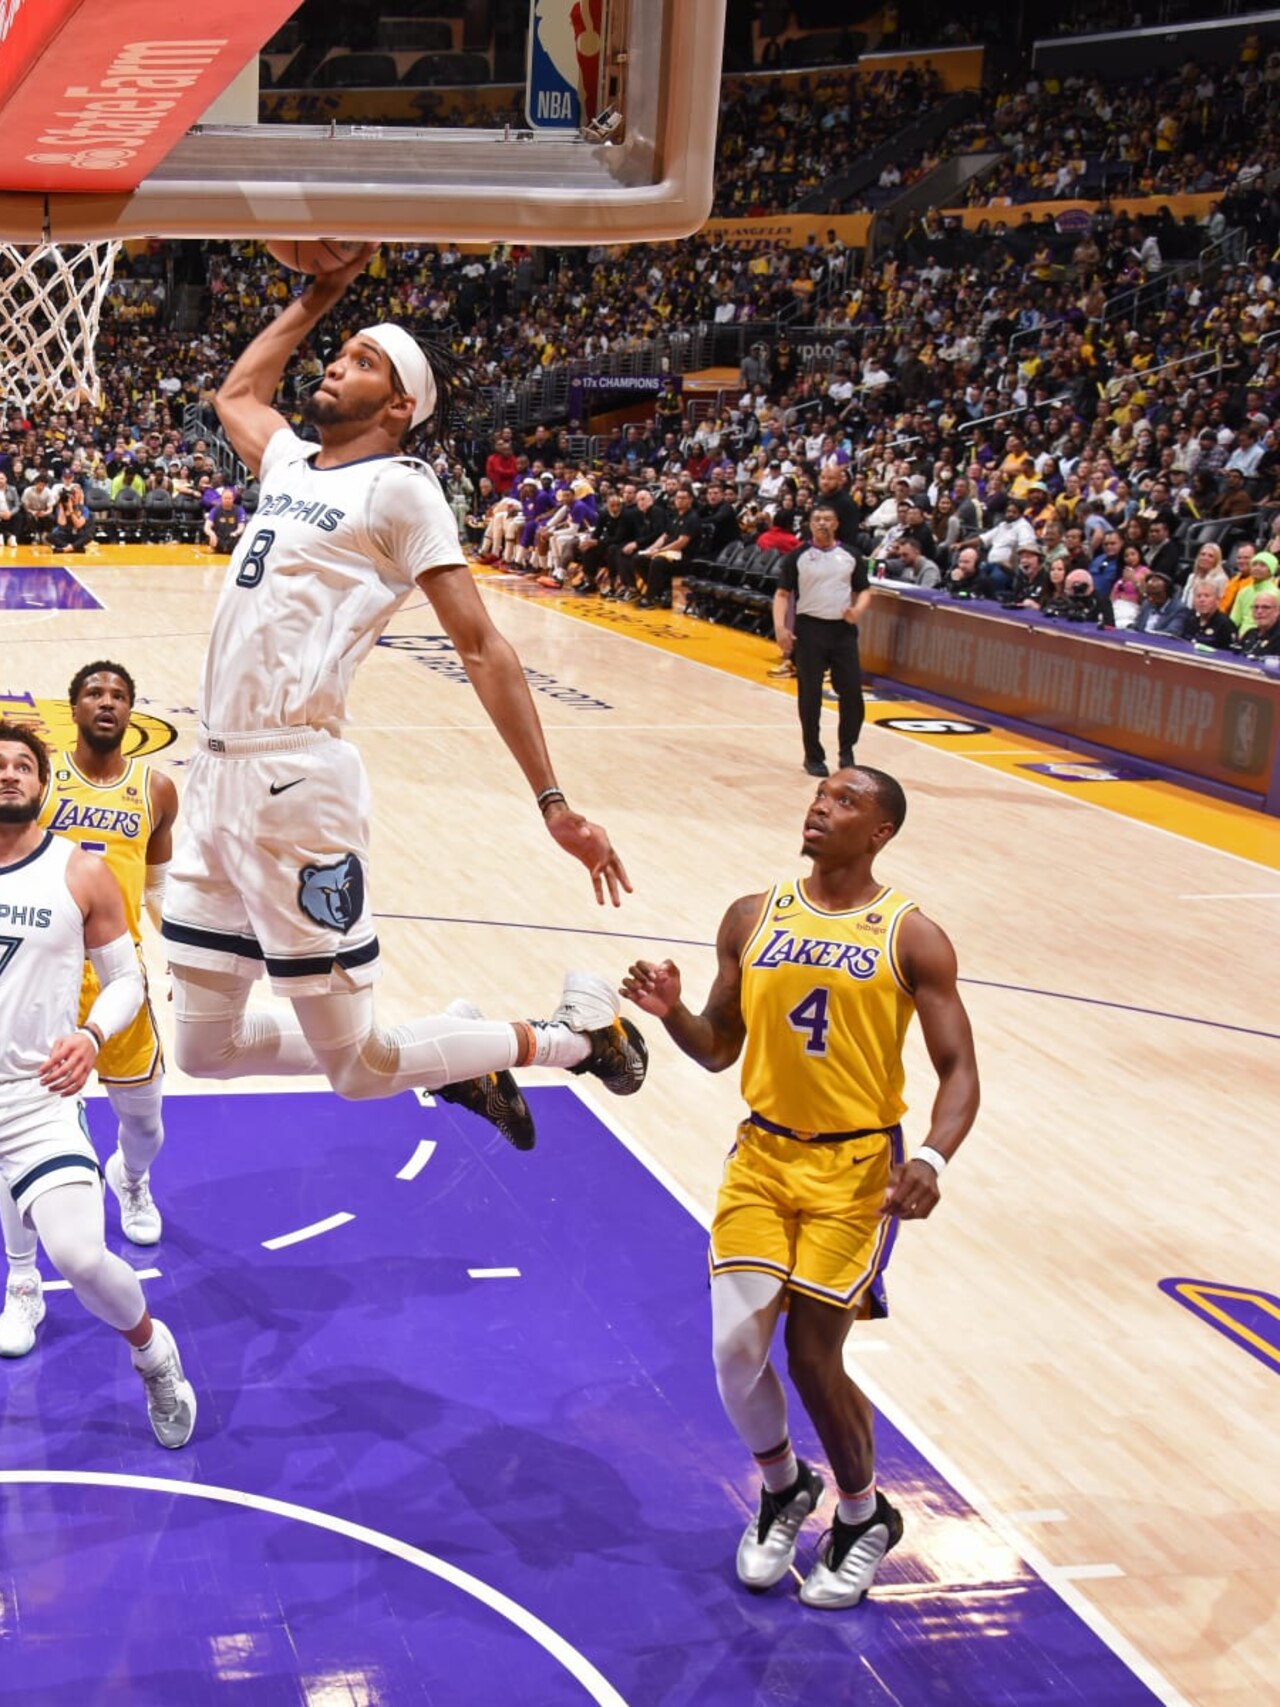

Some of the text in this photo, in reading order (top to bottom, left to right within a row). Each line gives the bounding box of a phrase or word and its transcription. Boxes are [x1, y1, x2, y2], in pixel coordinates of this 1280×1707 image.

[537, 91, 572, 120] NBA
[598, 377, 660, 389] CHAMPIONS
[236, 528, 276, 589] 8
[1028, 649, 1076, 714] WITH
[1079, 661, 1119, 725] THE
[1118, 671, 1164, 740] NBA
[1166, 684, 1215, 752] APP
[47, 798, 141, 838] LAKERS
[778, 895, 793, 908] 6
[752, 930, 880, 979] LAKERS
[787, 987, 830, 1056] 4
